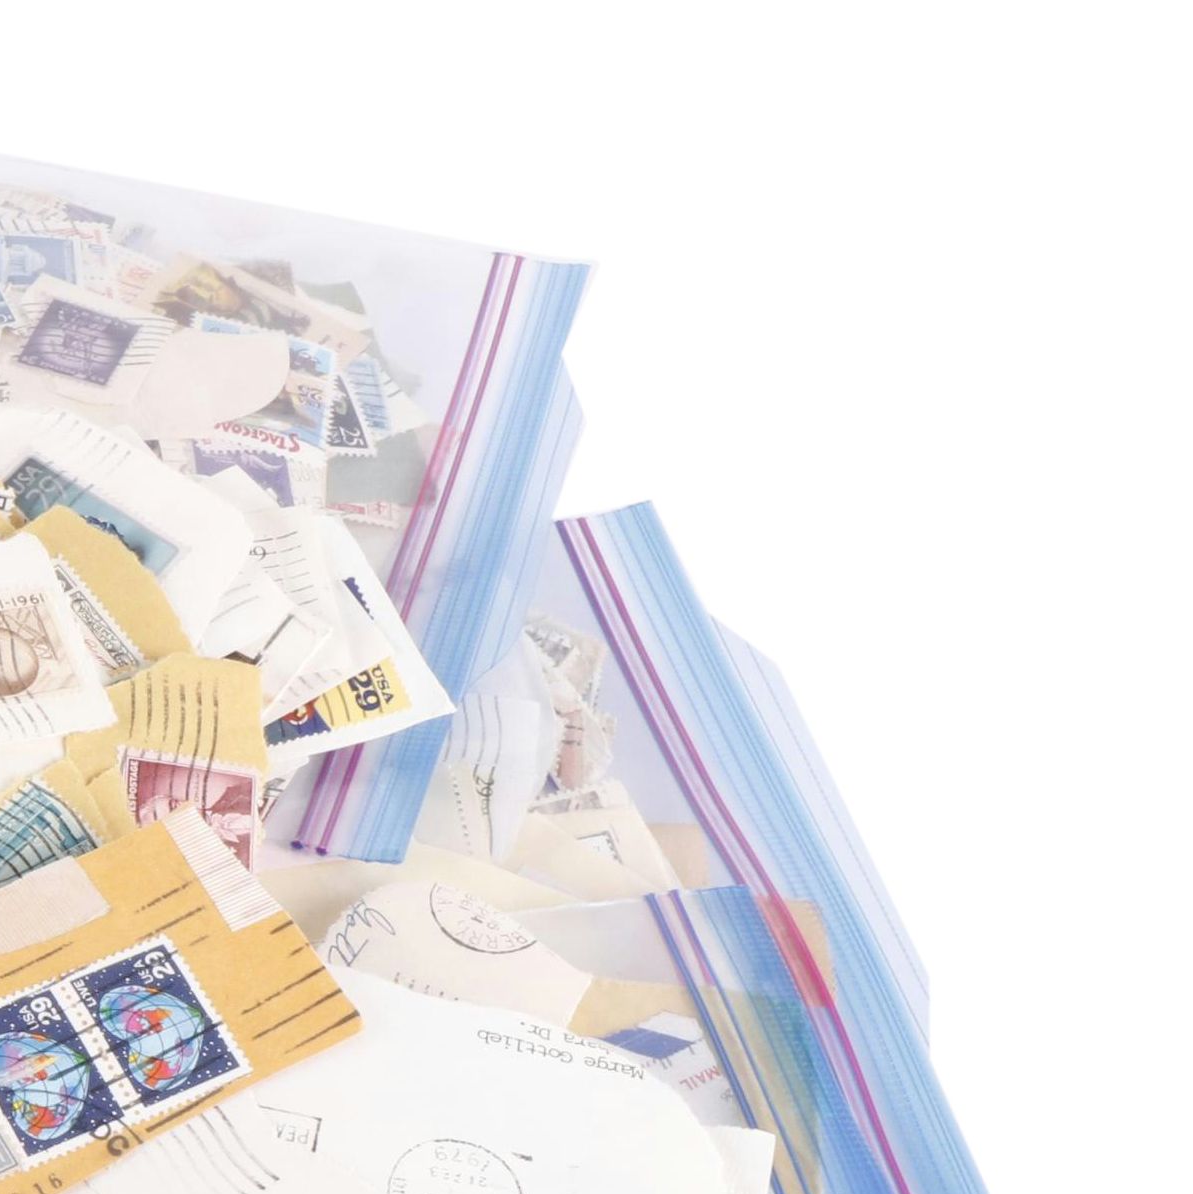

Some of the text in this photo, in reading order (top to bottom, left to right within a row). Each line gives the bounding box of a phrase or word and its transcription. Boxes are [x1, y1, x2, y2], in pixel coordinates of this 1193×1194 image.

[338, 426, 364, 447] 25
[12, 463, 42, 493] USA
[25, 476, 67, 508] 29
[347, 669, 382, 713] 29
[370, 663, 395, 706] USA
[127, 759, 139, 801] POSTAGE
[72, 979, 97, 1008] LOVE
[18, 1004, 40, 1030] USA
[30, 995, 62, 1027] 29
[476, 1027, 574, 1064] Gottlieb
[583, 1054, 645, 1081] Marge
[678, 1064, 722, 1092] MAIL
